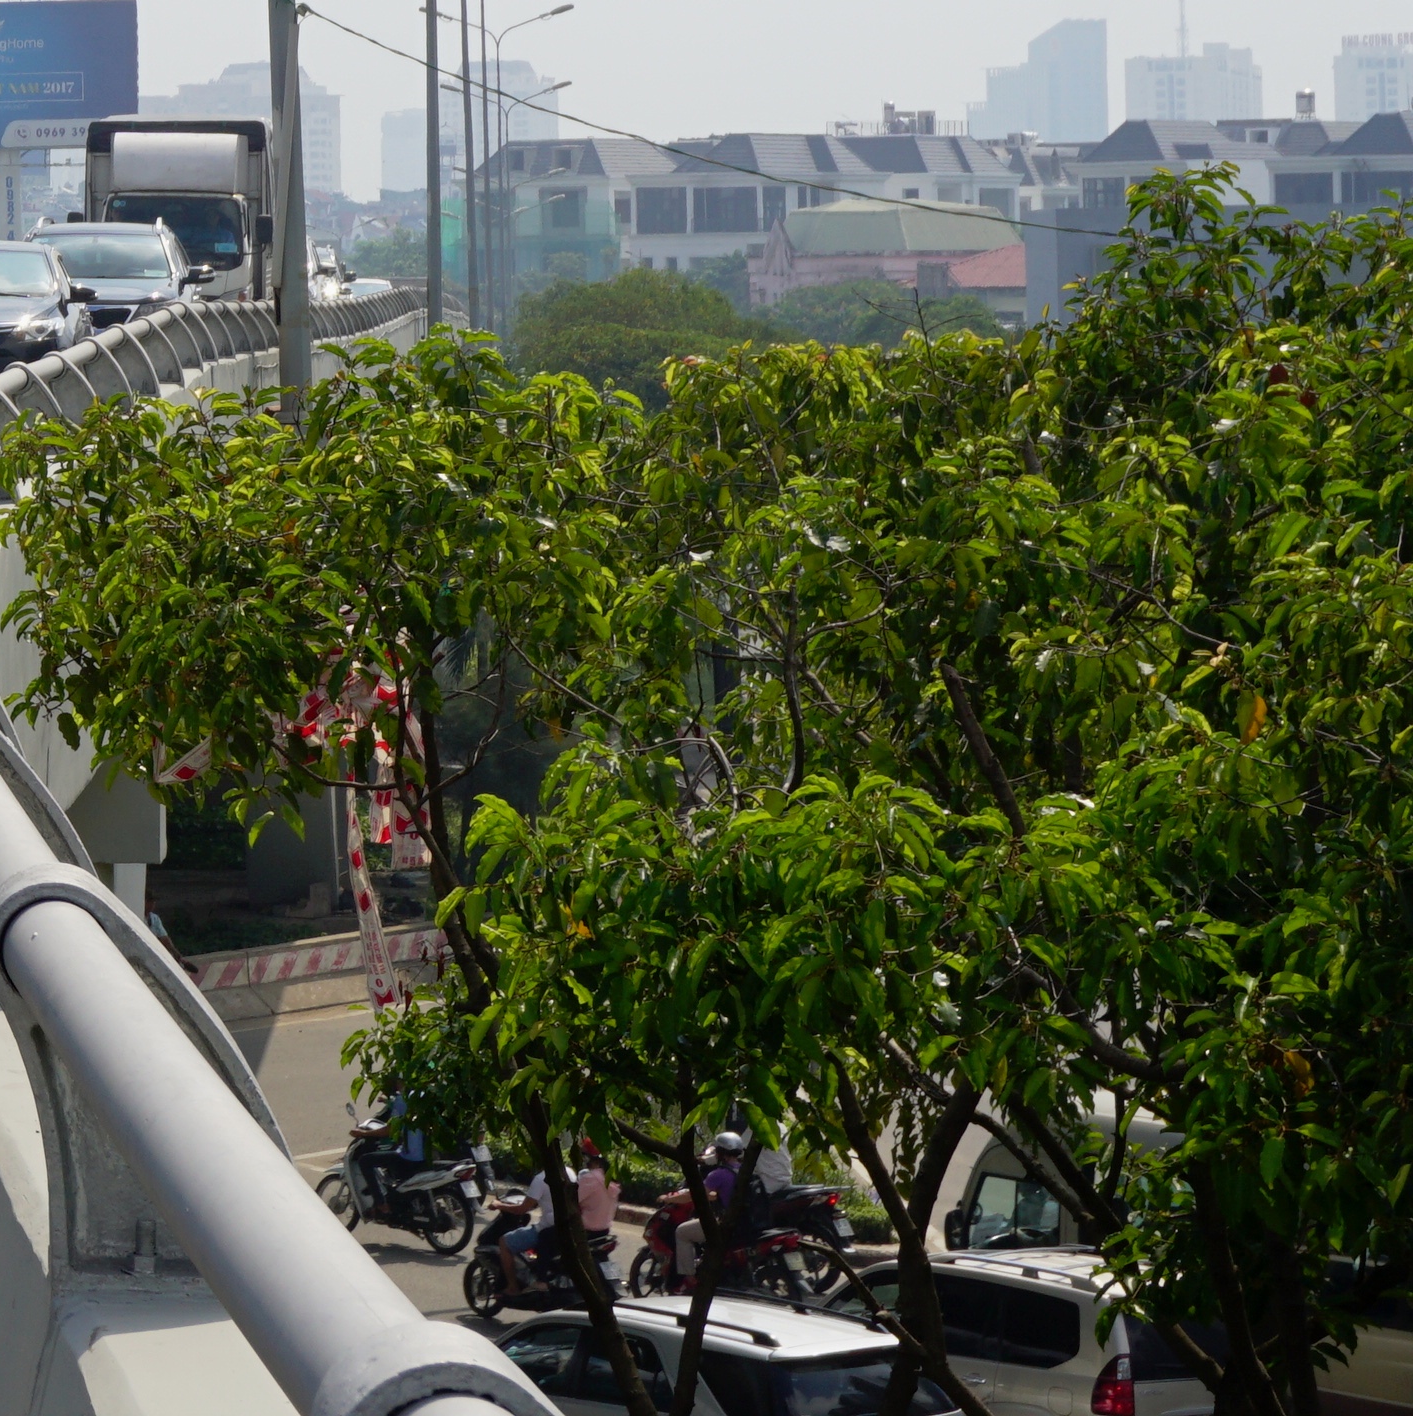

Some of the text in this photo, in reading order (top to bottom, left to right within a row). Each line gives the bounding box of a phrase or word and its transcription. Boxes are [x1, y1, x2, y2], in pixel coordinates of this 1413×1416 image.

[8, 82, 40, 96] NAM
[42, 81, 75, 95] 2017
[36, 127, 66, 138] 0969
